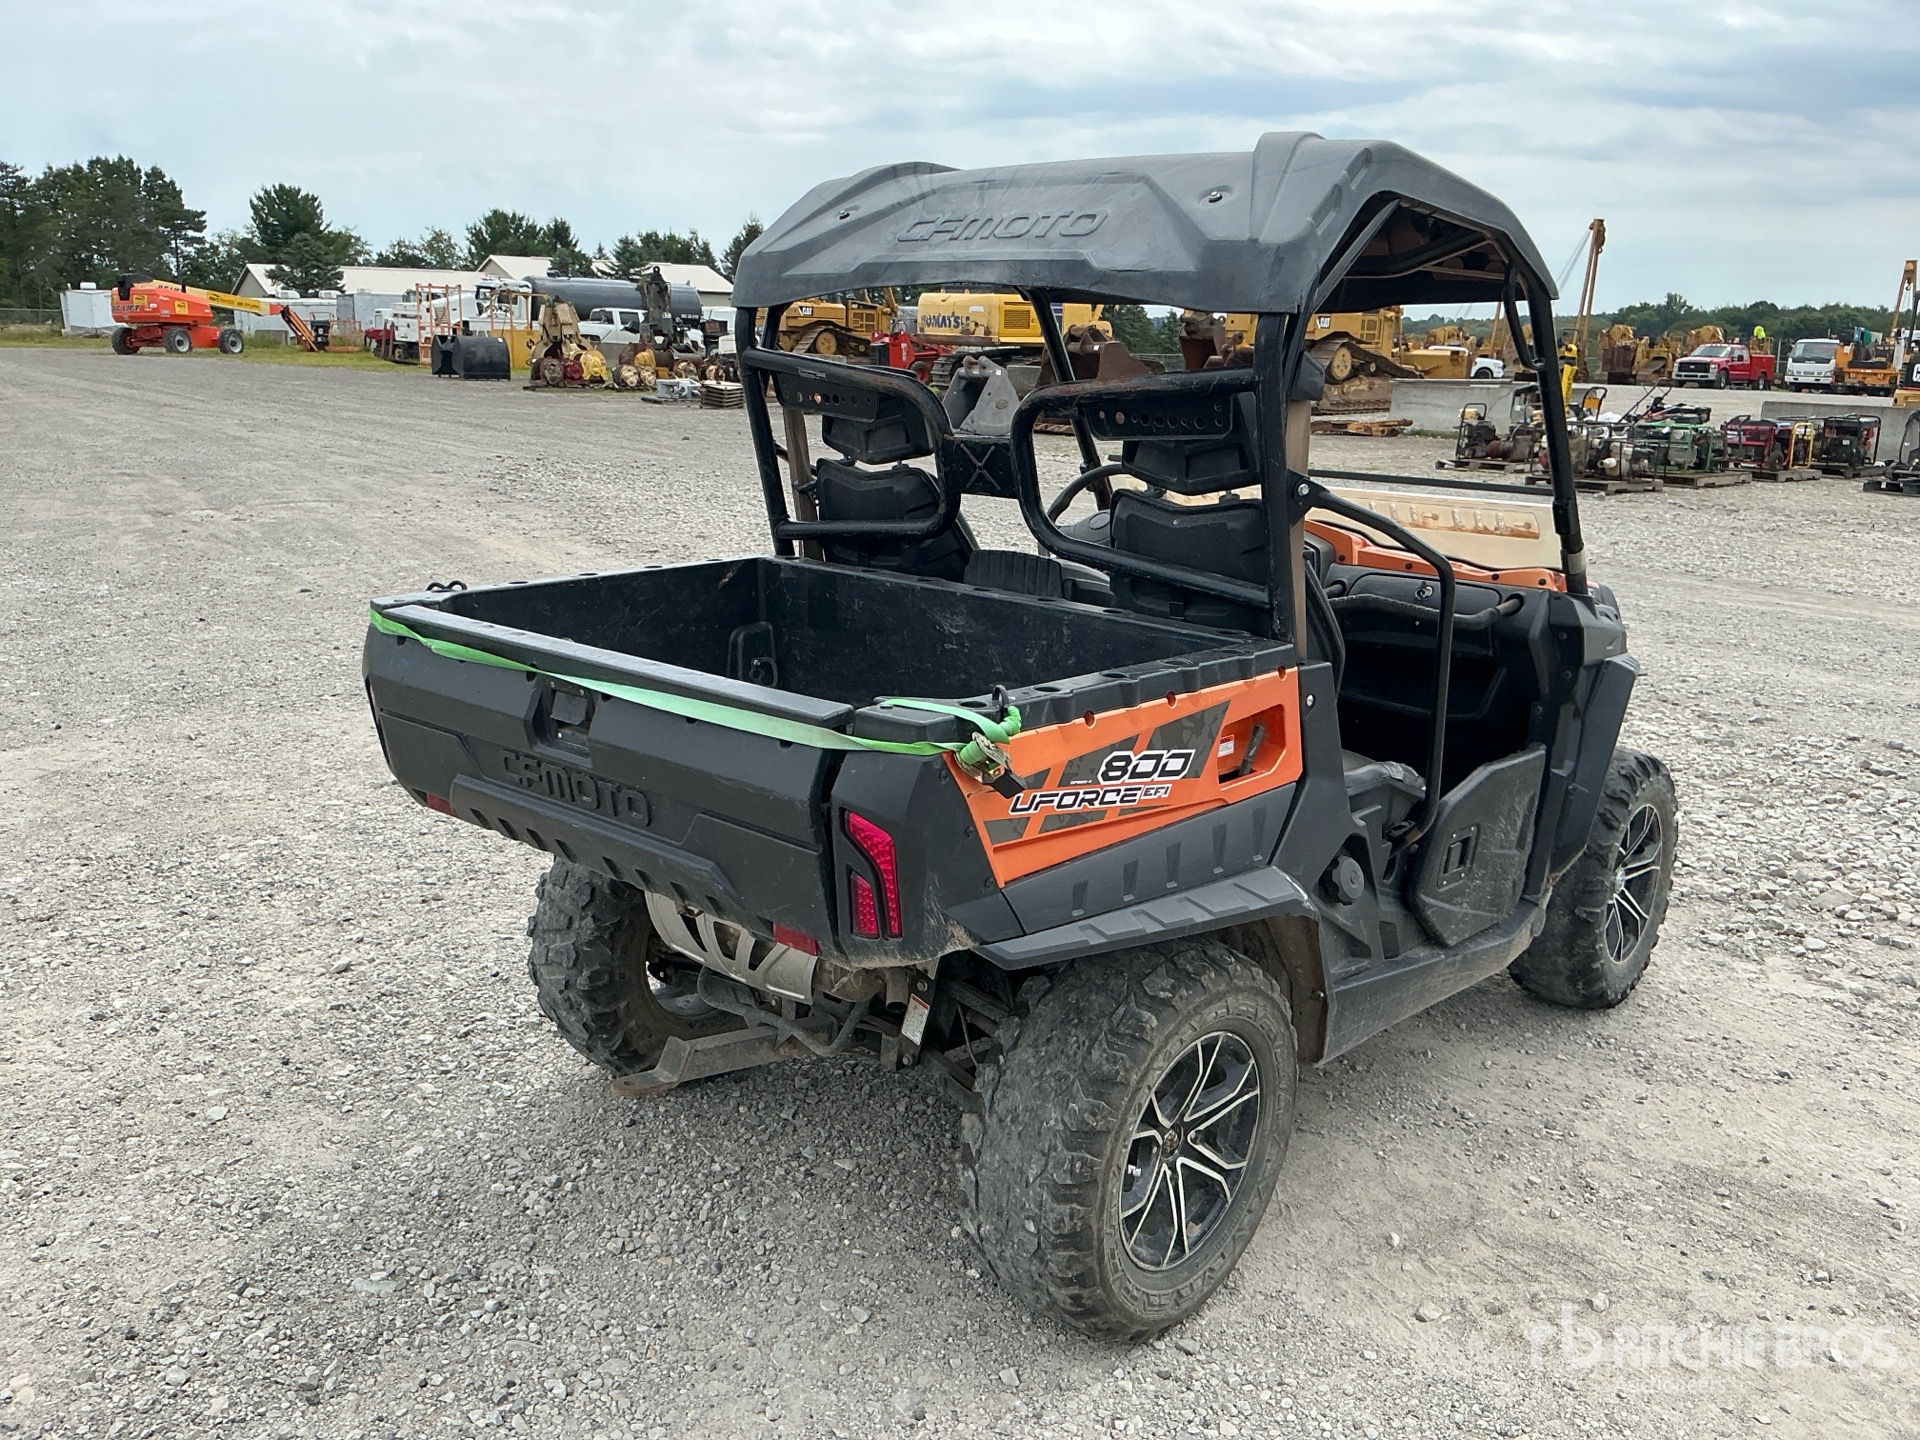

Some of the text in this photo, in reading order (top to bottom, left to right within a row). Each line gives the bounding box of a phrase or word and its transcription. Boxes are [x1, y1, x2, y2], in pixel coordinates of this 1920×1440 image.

[897, 211, 1108, 242] CFMOTO
[1098, 750, 1195, 784] 800
[503, 750, 652, 827] CFMOTO
[1010, 785, 1171, 814] UFORCE EFI
